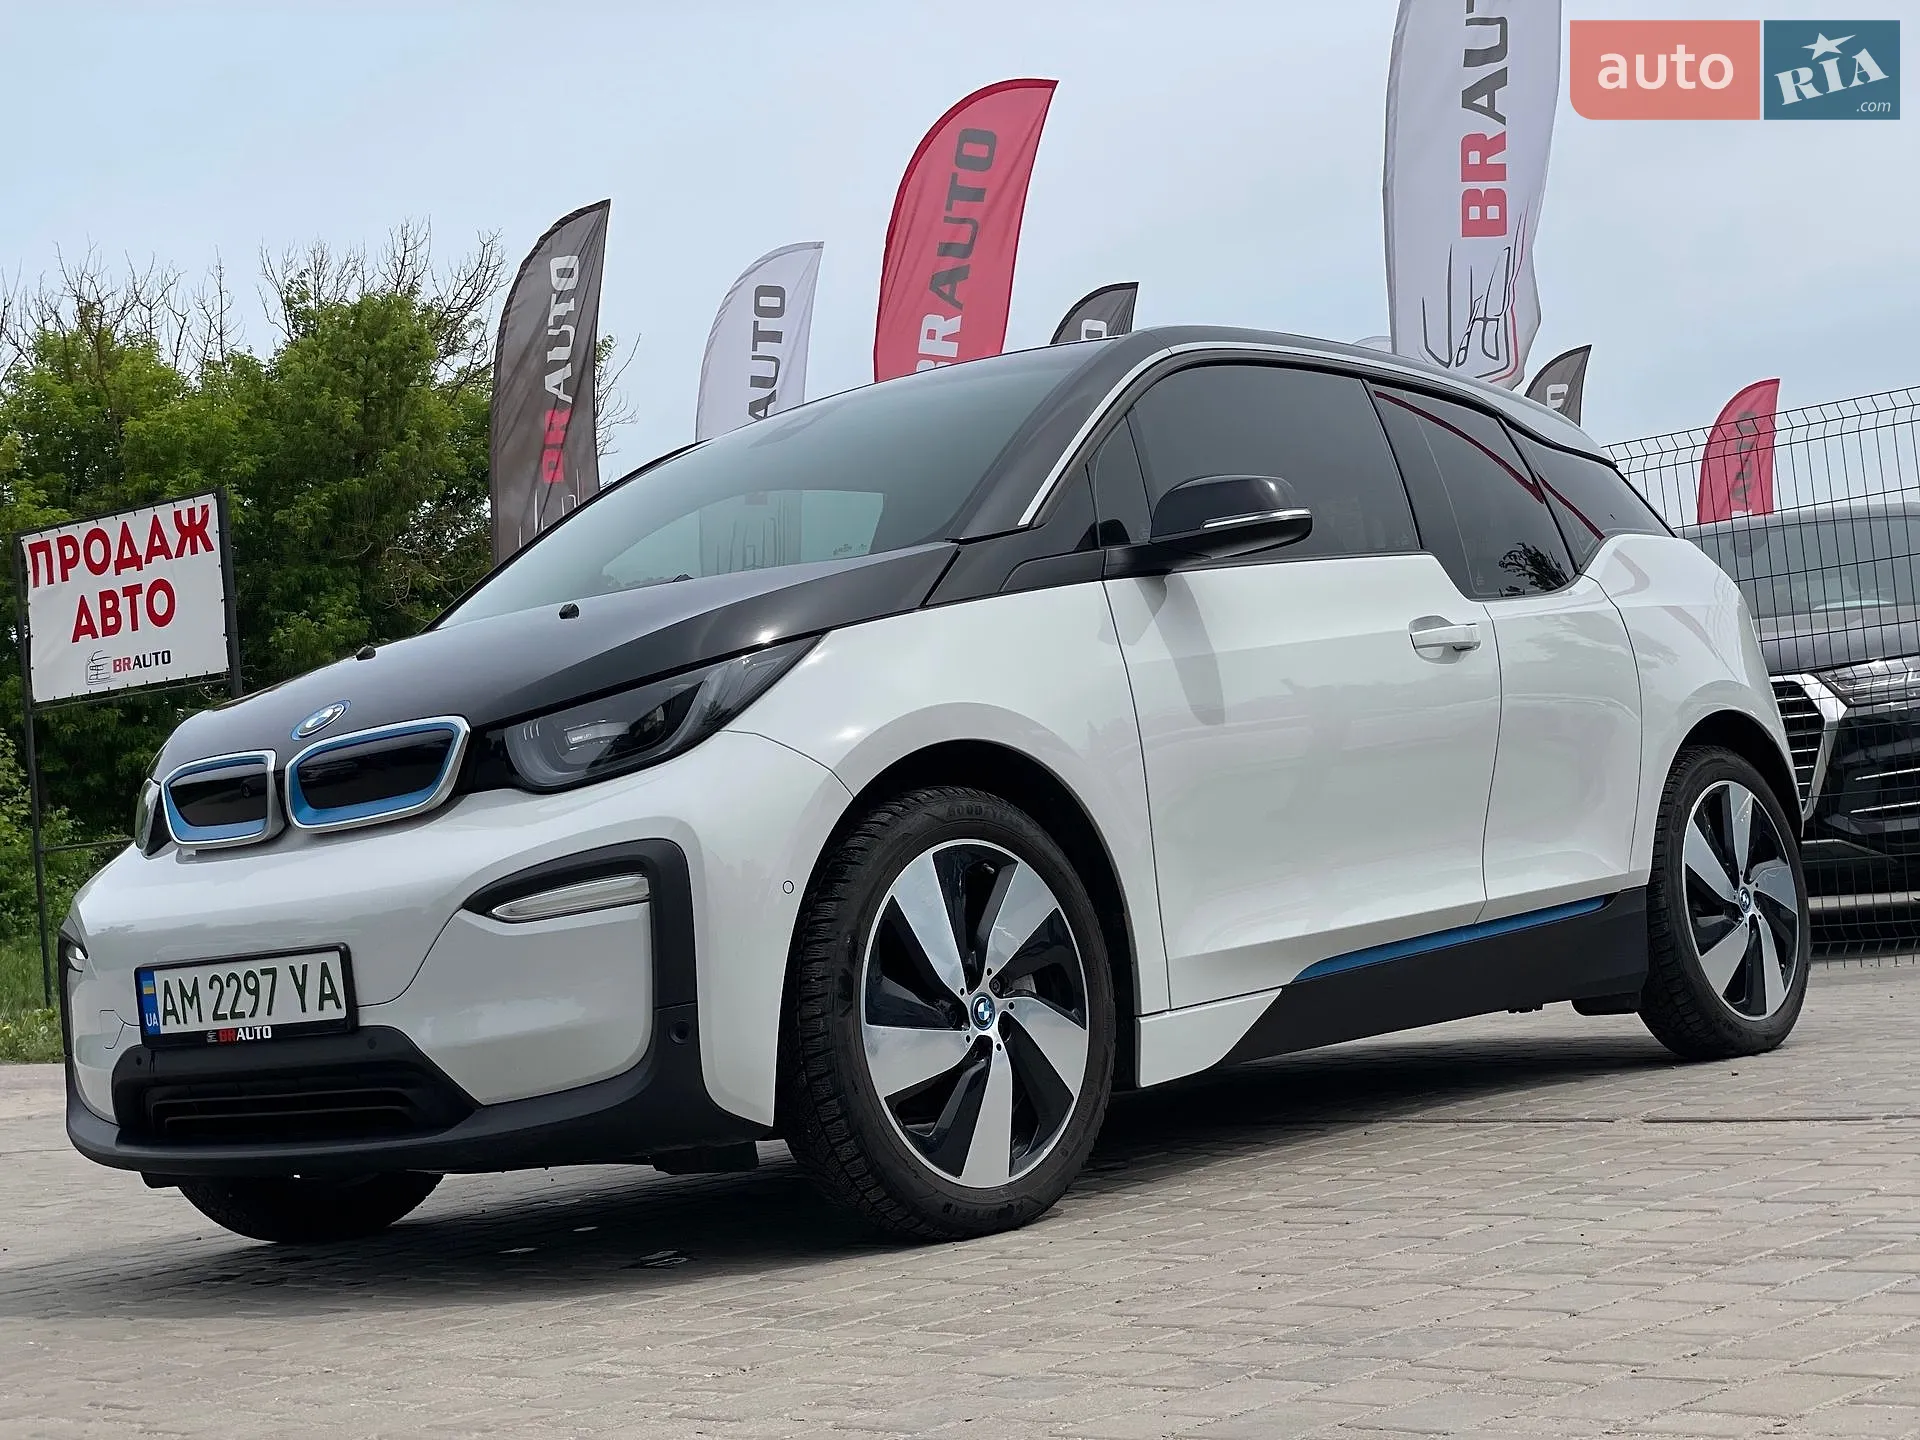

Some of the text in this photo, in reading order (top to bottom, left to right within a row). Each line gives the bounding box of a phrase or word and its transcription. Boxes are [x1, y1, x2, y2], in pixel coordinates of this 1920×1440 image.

[542, 255, 579, 484] BRAUTO
[28, 504, 214, 588] ПРОДАЖ
[72, 578, 176, 643] АВТО
[112, 650, 171, 673] BRAUTO
[145, 1012, 159, 1027] UA
[163, 961, 342, 1025] AM 2297 YA
[218, 1025, 272, 1042] BRAUTO
